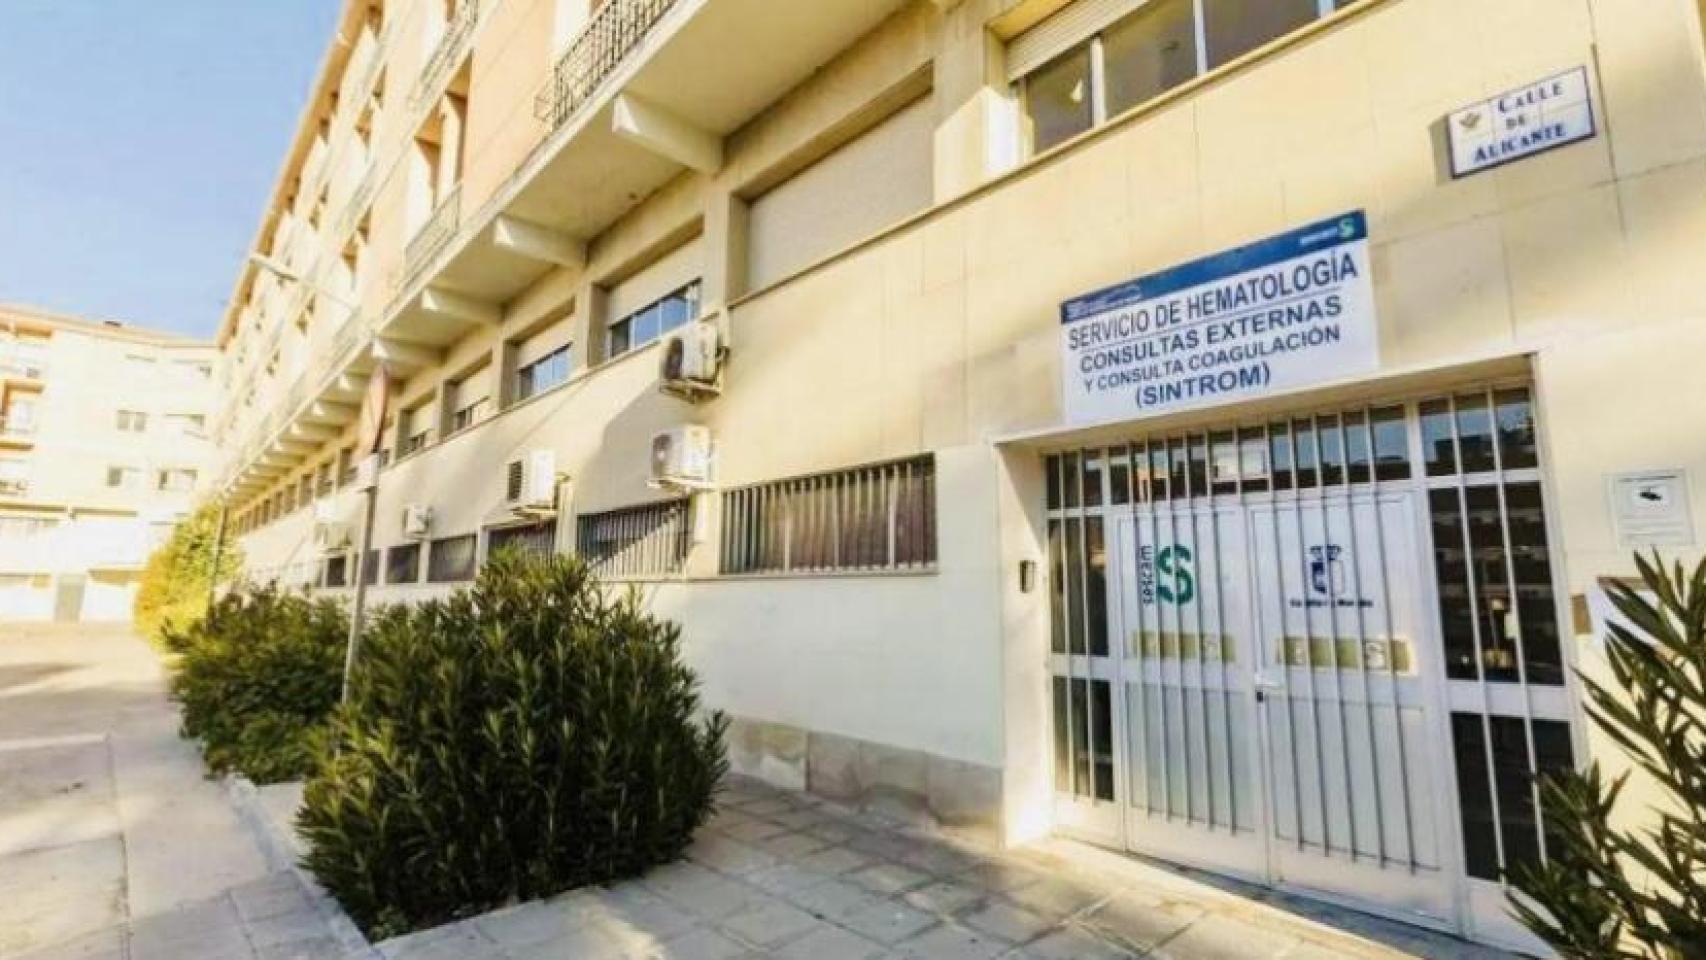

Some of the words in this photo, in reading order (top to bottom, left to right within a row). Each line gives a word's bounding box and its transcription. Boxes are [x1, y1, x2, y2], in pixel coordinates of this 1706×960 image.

[1069, 309, 1150, 350] SERVICIO
[1155, 299, 1182, 329] DE
[1187, 250, 1359, 320] HEMATOLOGÍA
[1080, 328, 1200, 374] CONSULTAS
[1206, 294, 1343, 345] EXTERNAS
[1084, 378, 1094, 394] Y
[1097, 358, 1185, 391] CONSULTA
[1188, 323, 1341, 374] COAGULACIÓN
[1135, 360, 1271, 409] (SINTROM)
